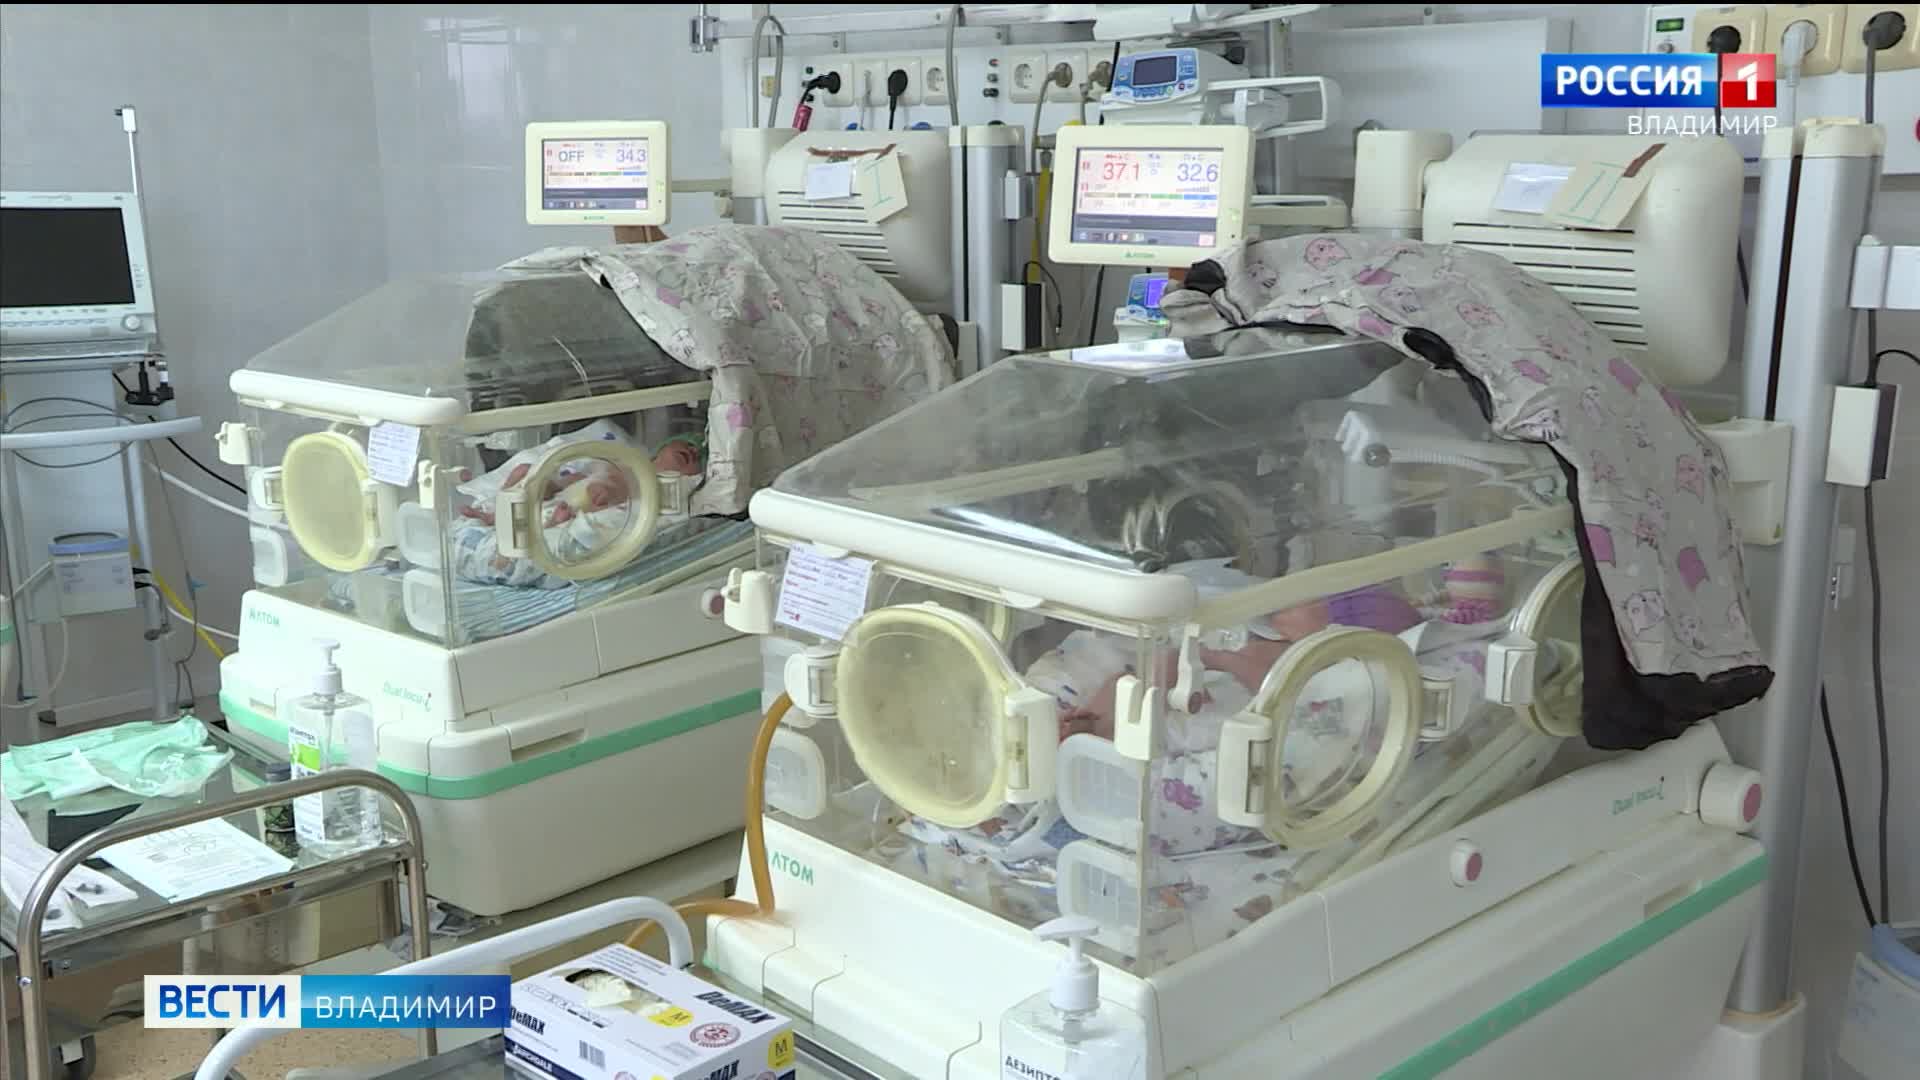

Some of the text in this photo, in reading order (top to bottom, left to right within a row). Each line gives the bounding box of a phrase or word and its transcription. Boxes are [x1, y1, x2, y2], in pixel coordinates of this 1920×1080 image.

[558, 149, 585, 163] OFF
[616, 148, 646, 163] 34.3
[1103, 162, 1140, 181] 37.1
[1177, 163, 1219, 183] 32.6
[771, 851, 814, 887] ATOM
[694, 991, 777, 1024] DeMAX
[775, 1038, 788, 1057] M
